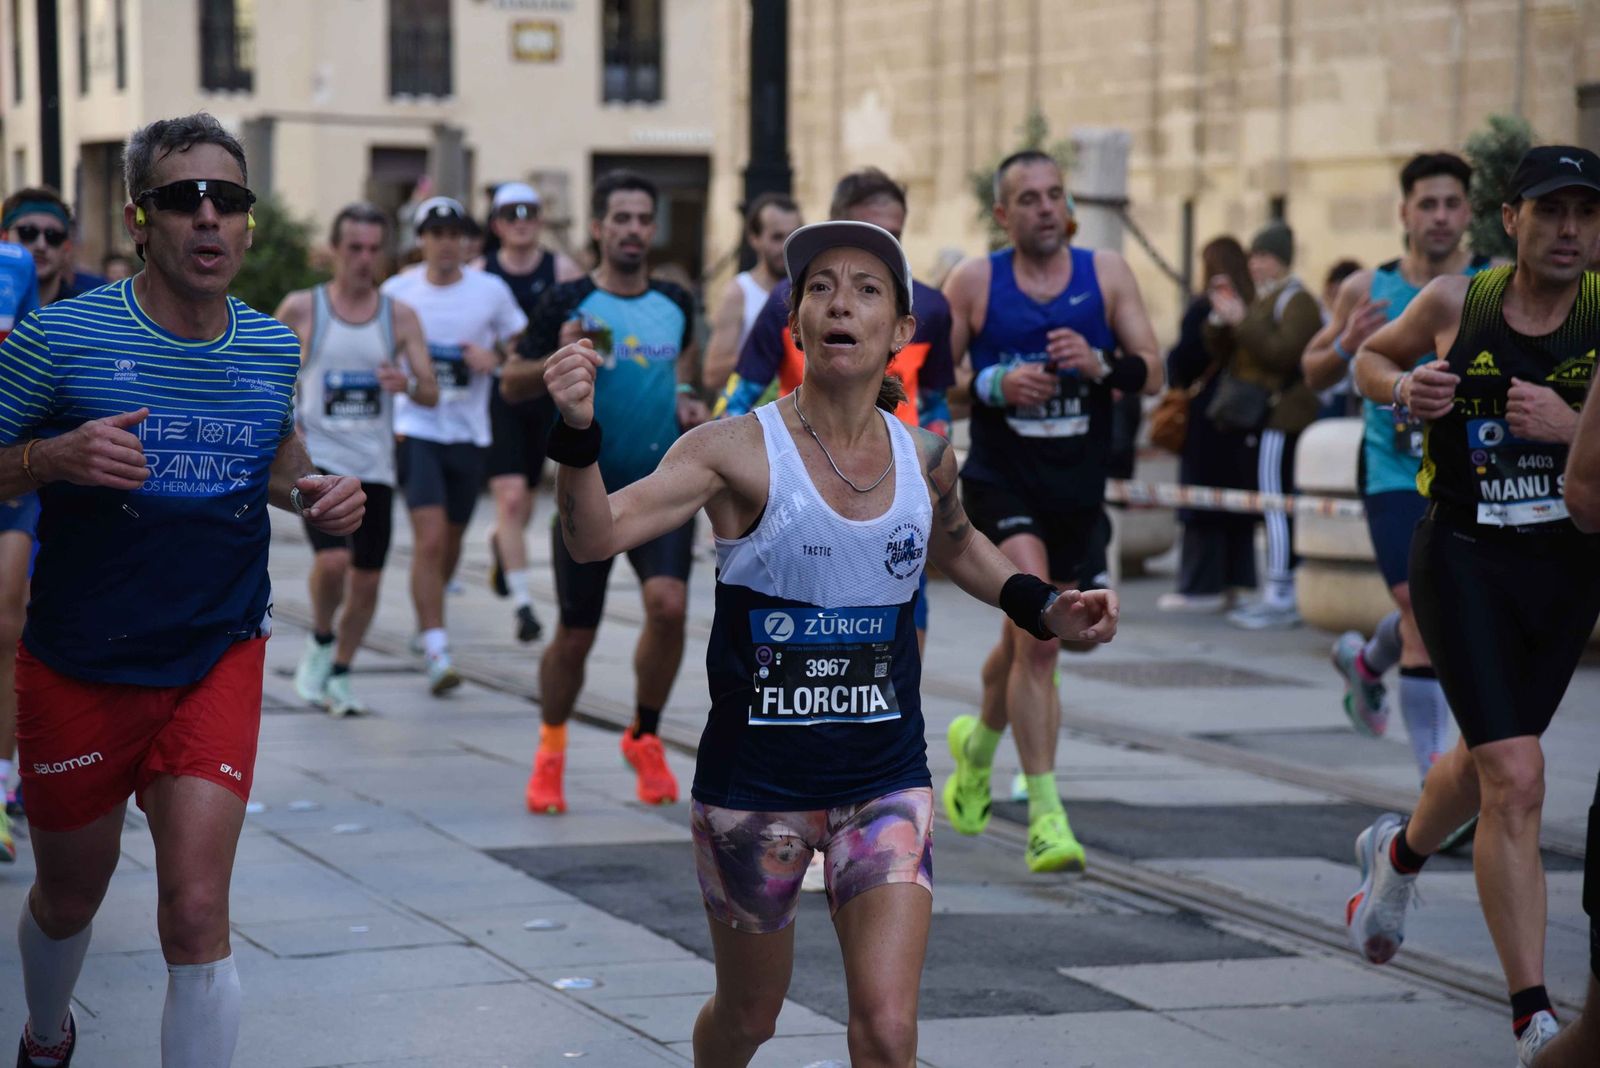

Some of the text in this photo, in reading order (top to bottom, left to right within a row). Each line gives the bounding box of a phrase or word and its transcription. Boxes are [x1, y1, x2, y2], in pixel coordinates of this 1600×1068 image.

[192, 415, 262, 449] TOTAL
[143, 448, 258, 492] RAINING
[1517, 455, 1554, 470] 4403
[142, 480, 225, 494] OS HERMANAS
[1480, 474, 1550, 502] MANU
[802, 544, 833, 557] TACTIC
[886, 537, 916, 554] PALMA
[889, 547, 924, 565] RUNNERS
[805, 658, 851, 678] 3967
[762, 684, 889, 715] FLORCITA
[33, 751, 104, 775] salomon
